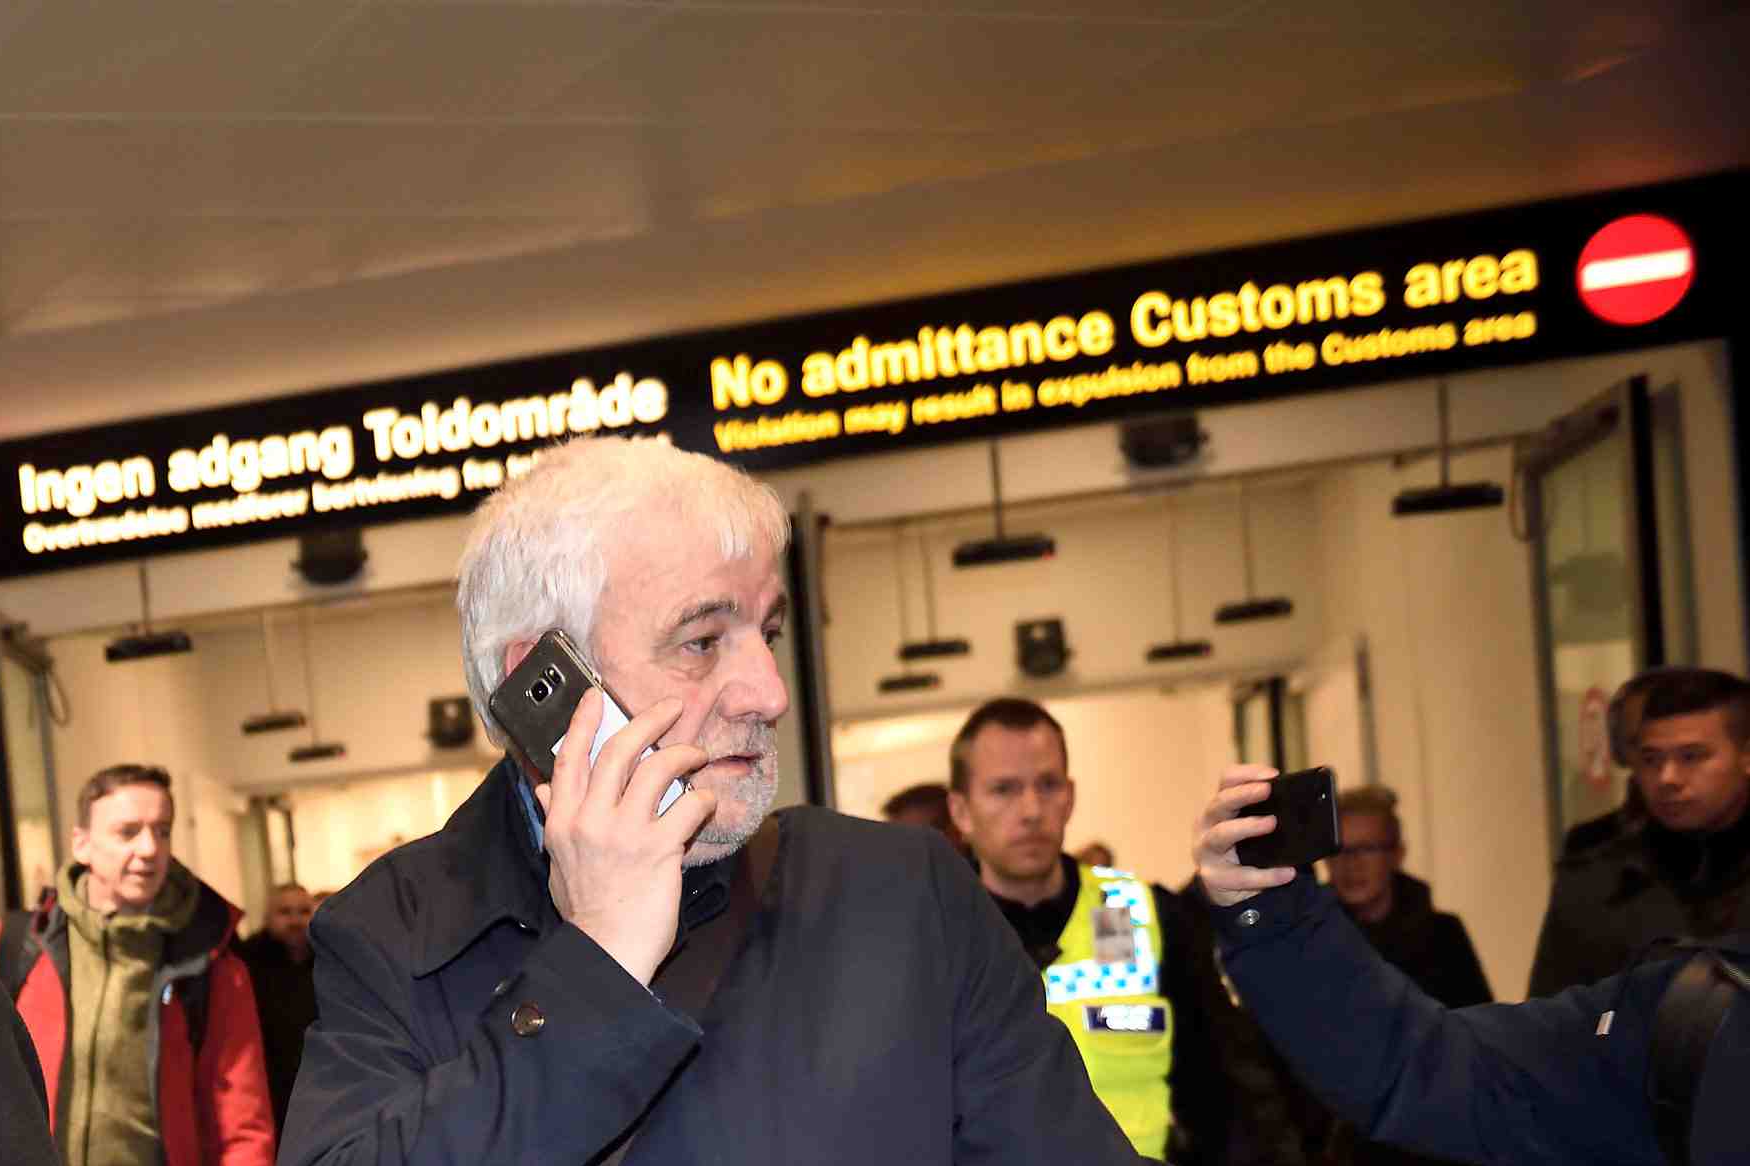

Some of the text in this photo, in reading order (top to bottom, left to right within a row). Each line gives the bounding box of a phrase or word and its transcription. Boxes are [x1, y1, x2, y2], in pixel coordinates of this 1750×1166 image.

[710, 248, 1540, 411] No admittance Customs area
[713, 311, 1536, 453] Violation may result in expulsion from the Customs area
[19, 371, 669, 517] Ingen adgang Toldområde
